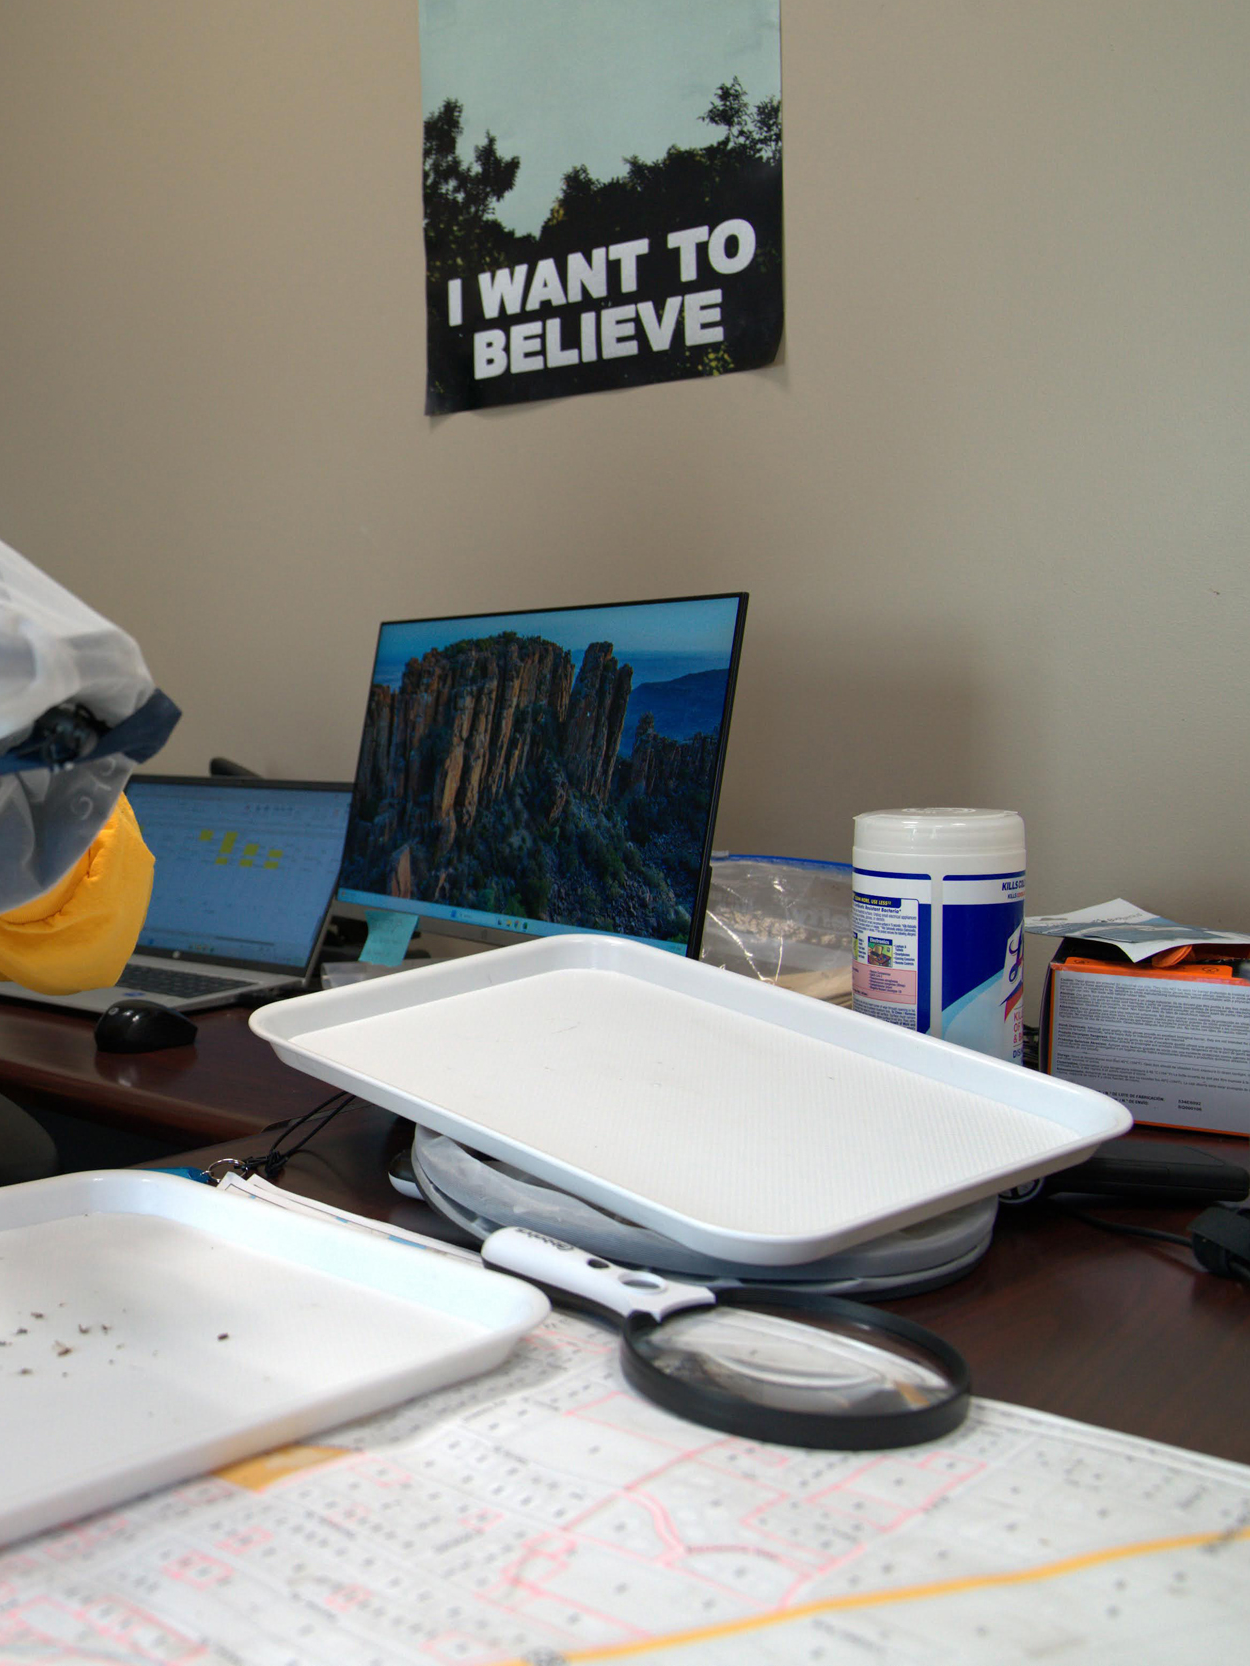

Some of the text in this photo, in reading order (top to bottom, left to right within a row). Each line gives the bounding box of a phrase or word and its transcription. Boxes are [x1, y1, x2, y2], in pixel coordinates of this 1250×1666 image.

[447, 218, 756, 327] I WANT TO
[474, 288, 724, 380] BELIEVE
[1002, 880, 1018, 891] KILLS
